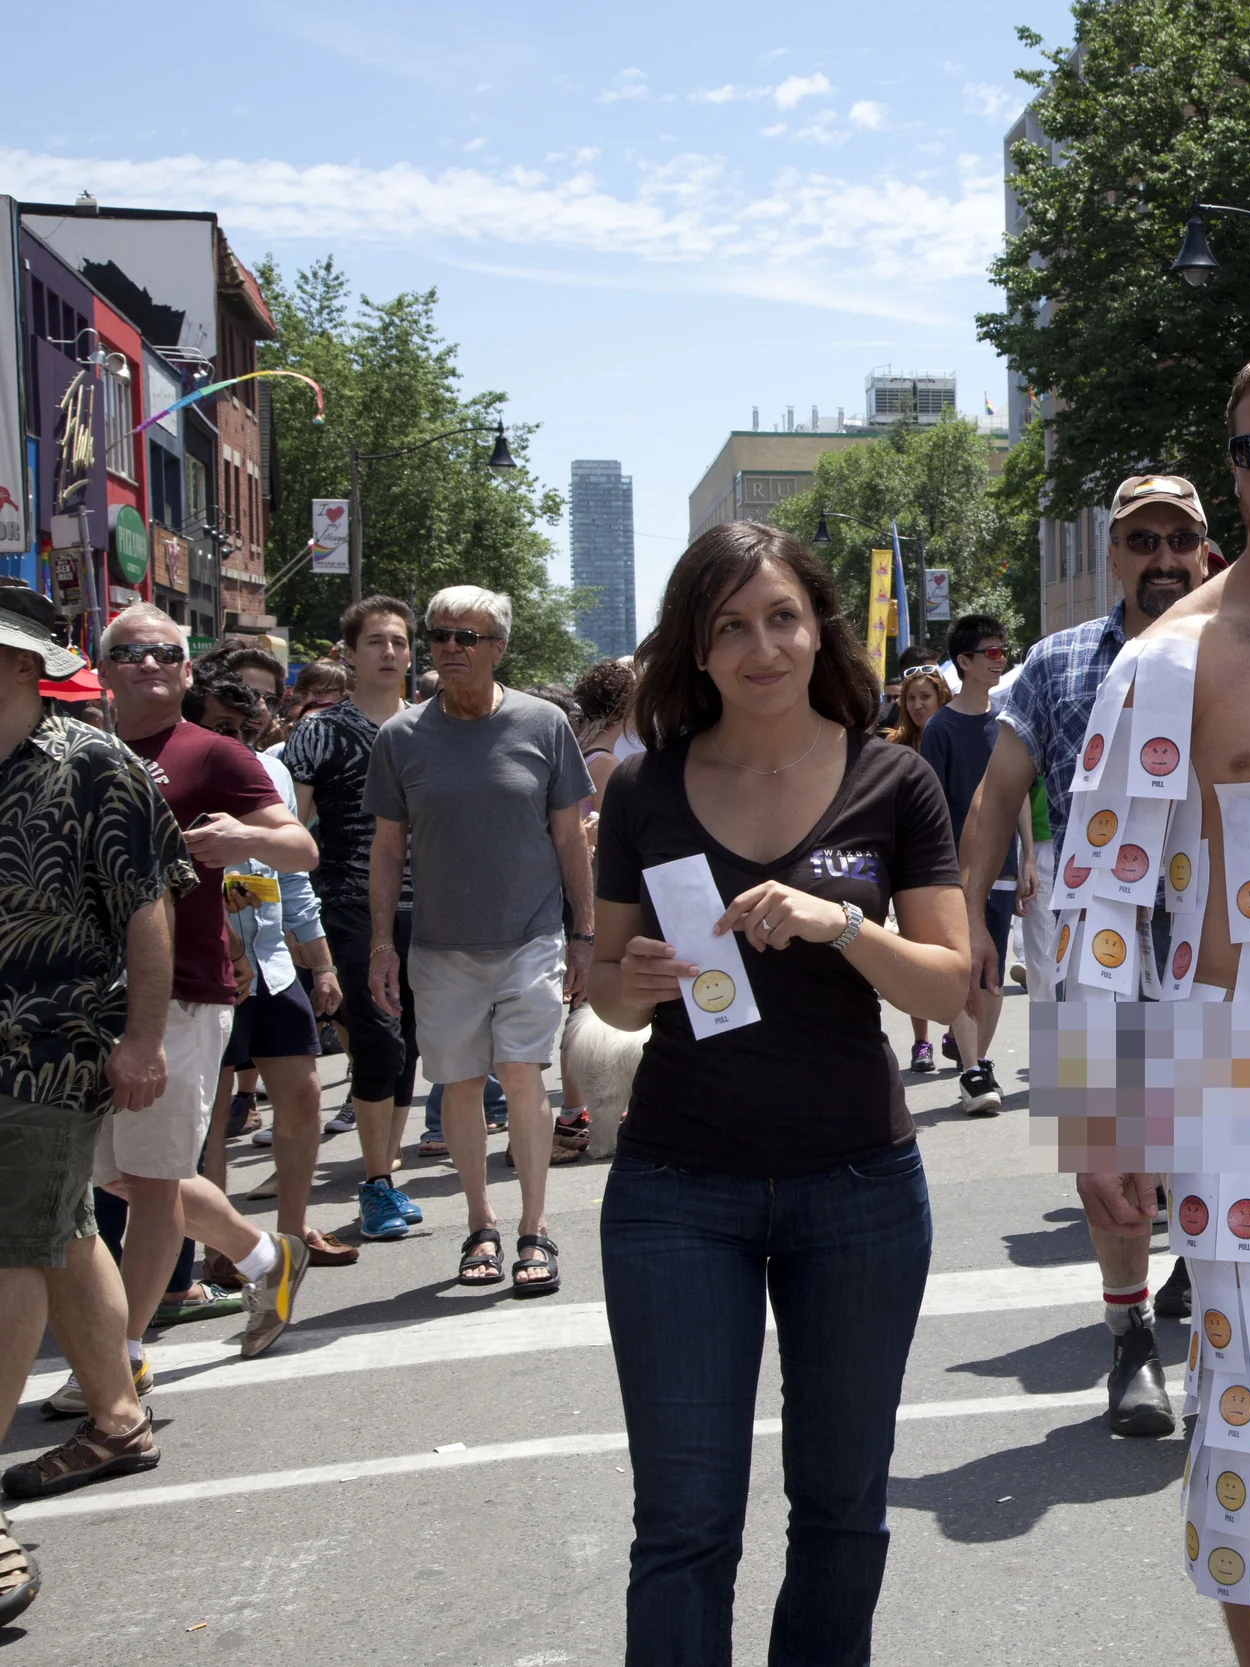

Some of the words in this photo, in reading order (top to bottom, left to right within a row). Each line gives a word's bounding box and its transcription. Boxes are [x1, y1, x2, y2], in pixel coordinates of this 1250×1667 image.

[317, 504, 328, 516] I
[327, 523, 341, 531] my
[1119, 886, 1131, 894] PULL
[1101, 971, 1112, 980] PULL
[715, 1016, 729, 1025] PULL
[1187, 1240, 1196, 1248] PULL
[1215, 1352, 1224, 1360] PULL
[1228, 1430, 1239, 1438] PULL
[1225, 1515, 1235, 1524] PULL
[1218, 1588, 1229, 1597] PULL
